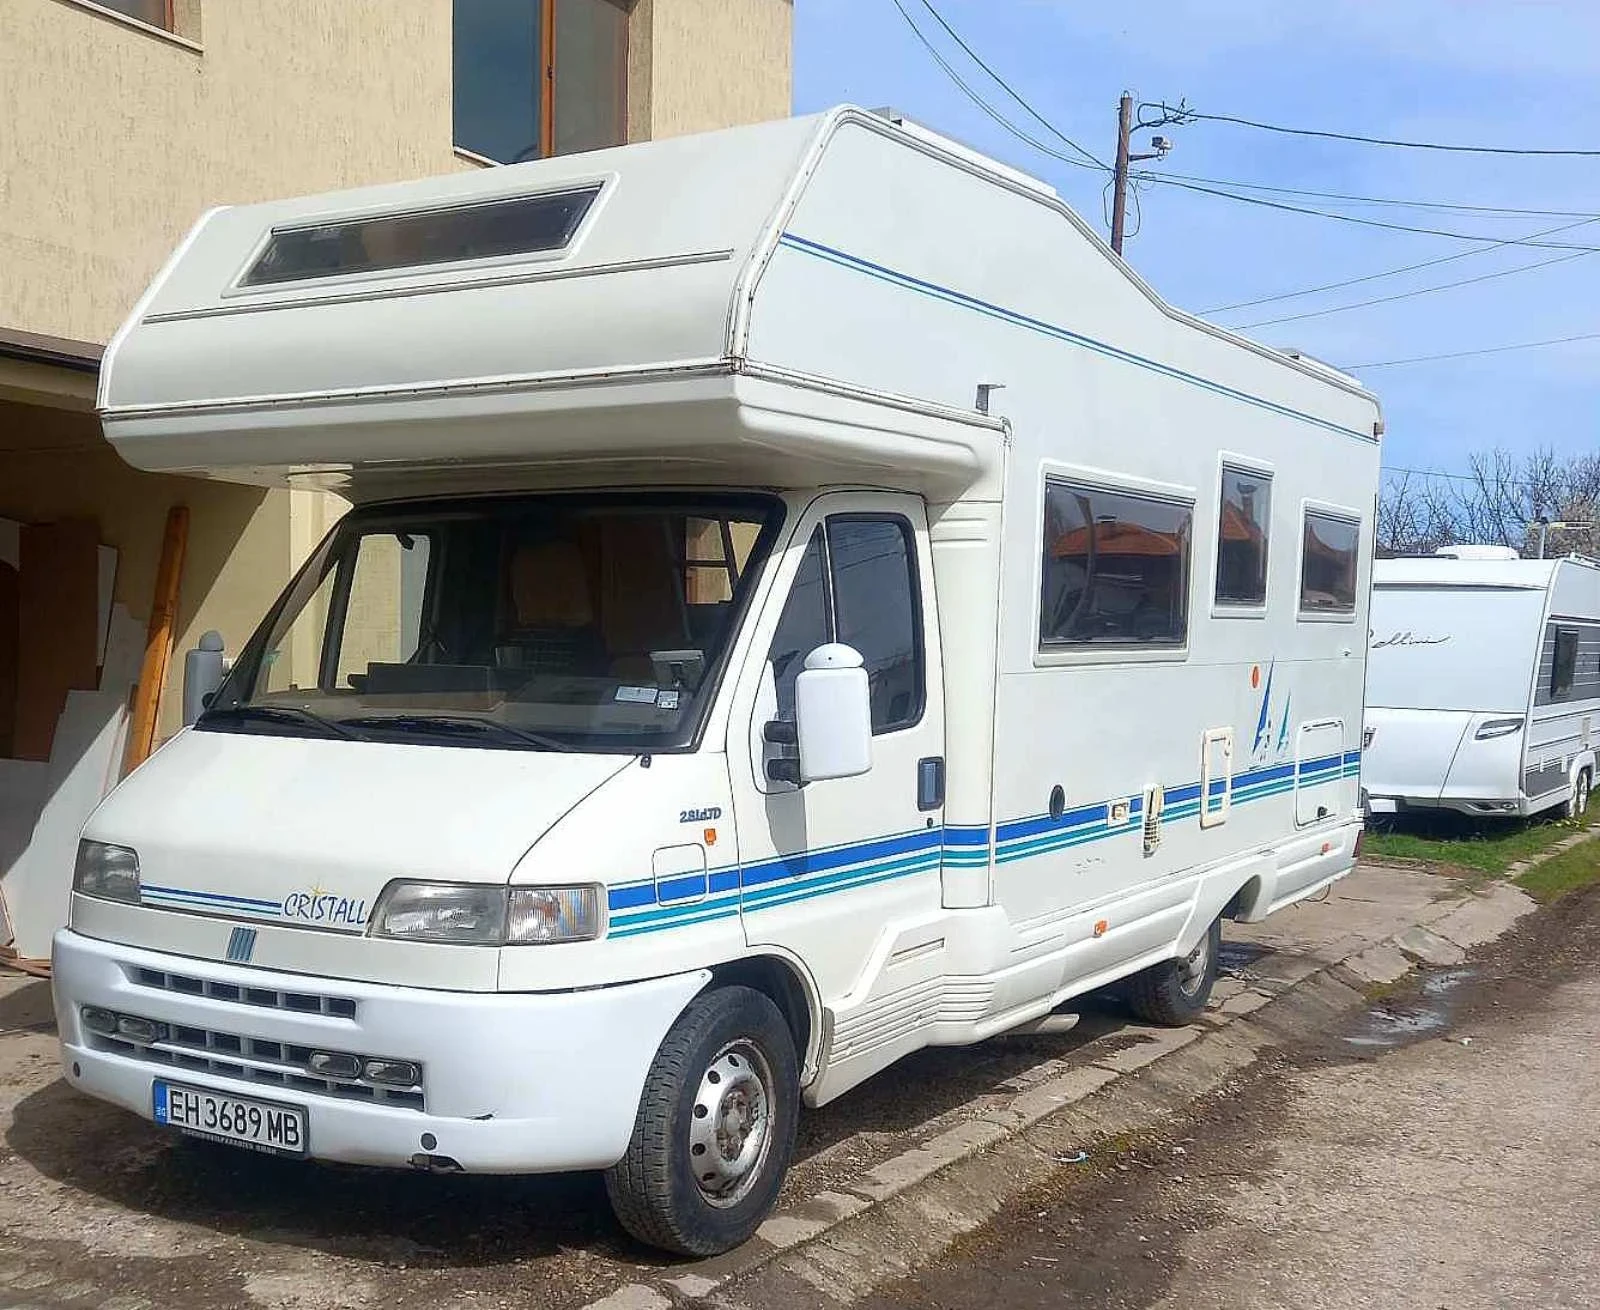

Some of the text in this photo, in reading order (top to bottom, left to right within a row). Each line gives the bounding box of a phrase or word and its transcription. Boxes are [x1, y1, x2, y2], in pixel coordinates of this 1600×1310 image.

[284, 893, 365, 924] CRISTALL
[170, 1090, 200, 1126] EH
[204, 1098, 262, 1137] 3689
[266, 1110, 300, 1146] MB
